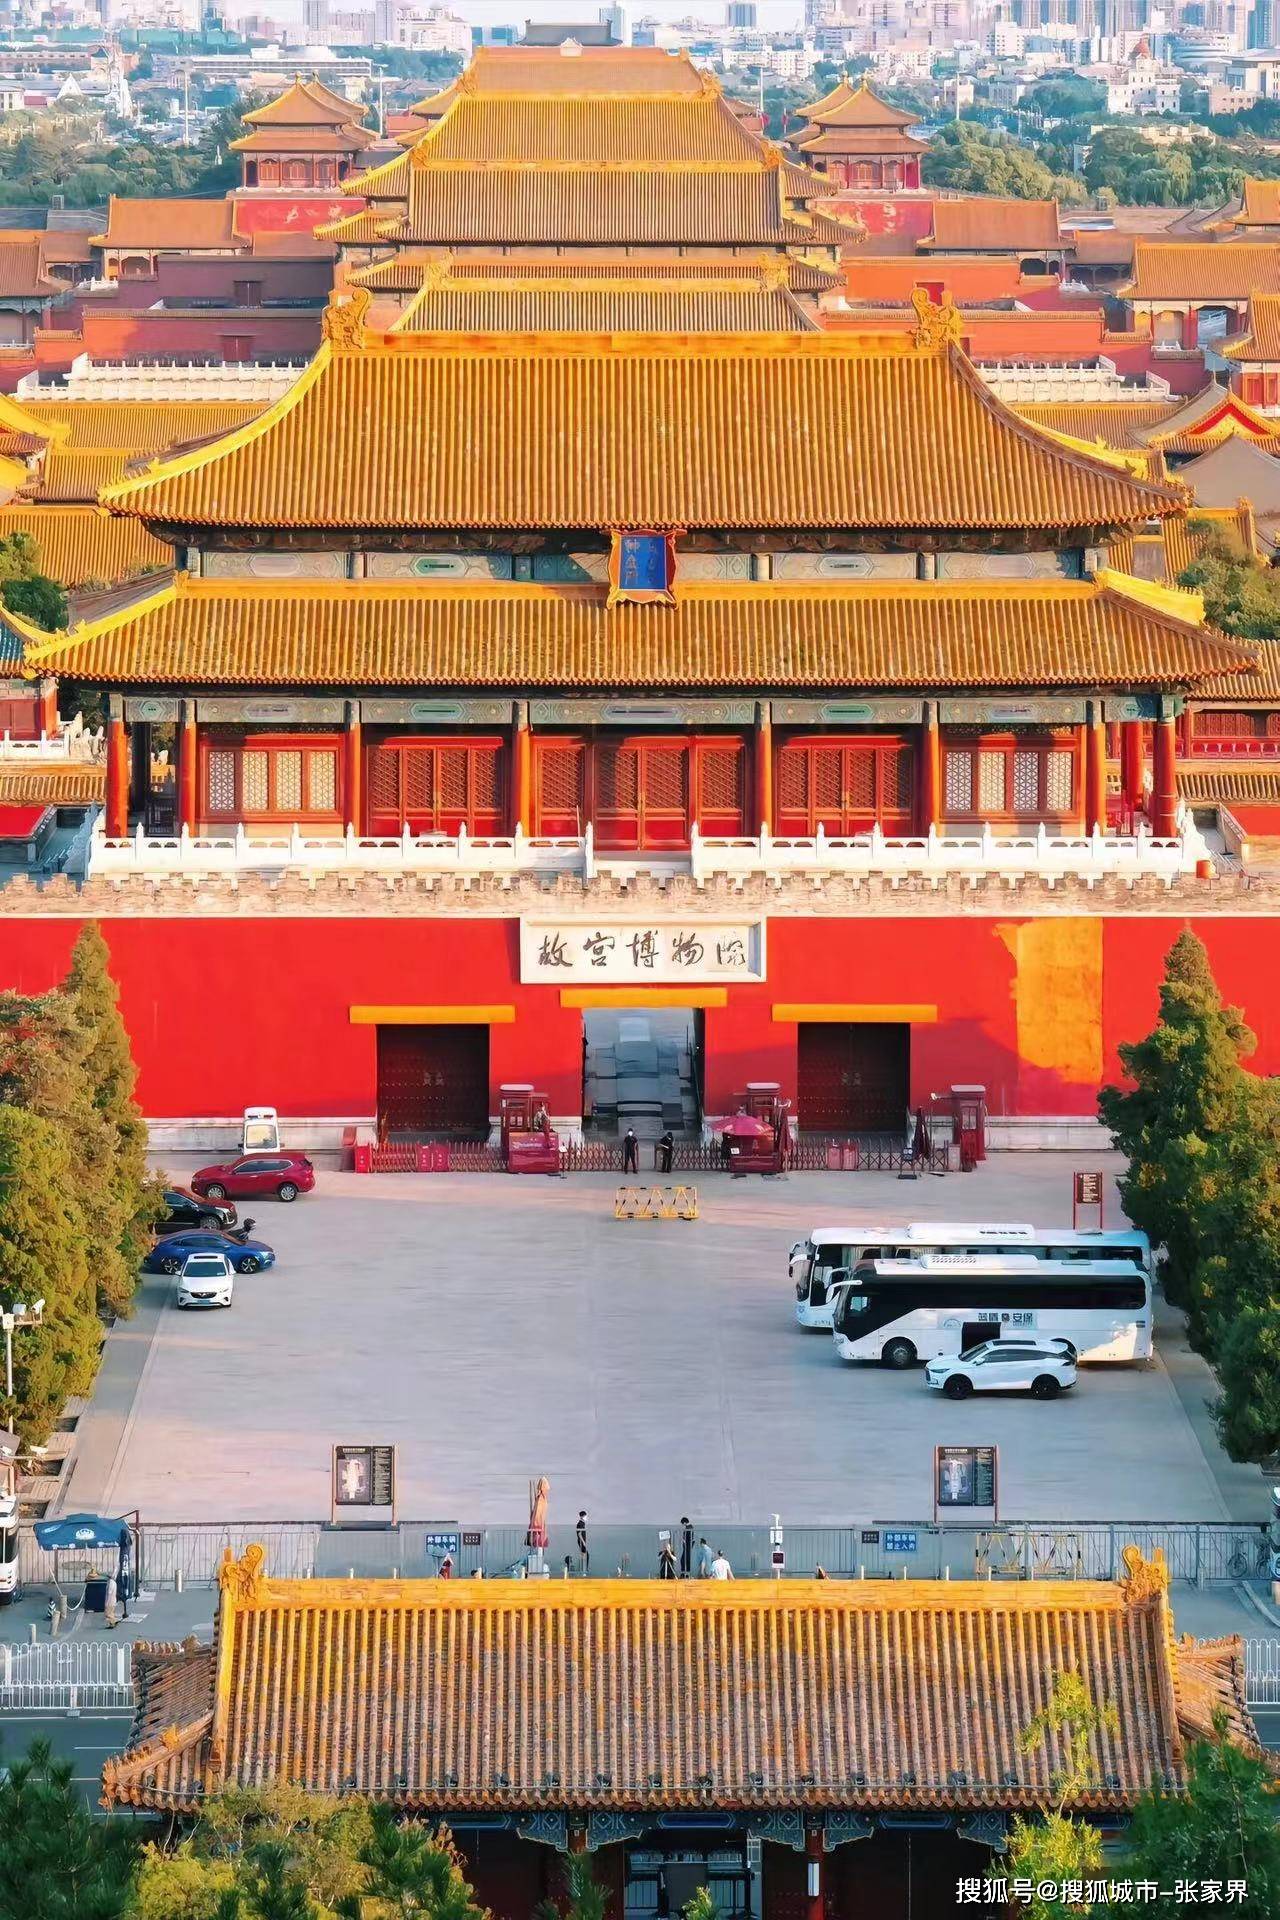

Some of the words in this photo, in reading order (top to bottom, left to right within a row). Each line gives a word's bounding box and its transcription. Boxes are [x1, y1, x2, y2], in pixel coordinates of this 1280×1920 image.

[537, 930, 746, 968] 故宫博物院
